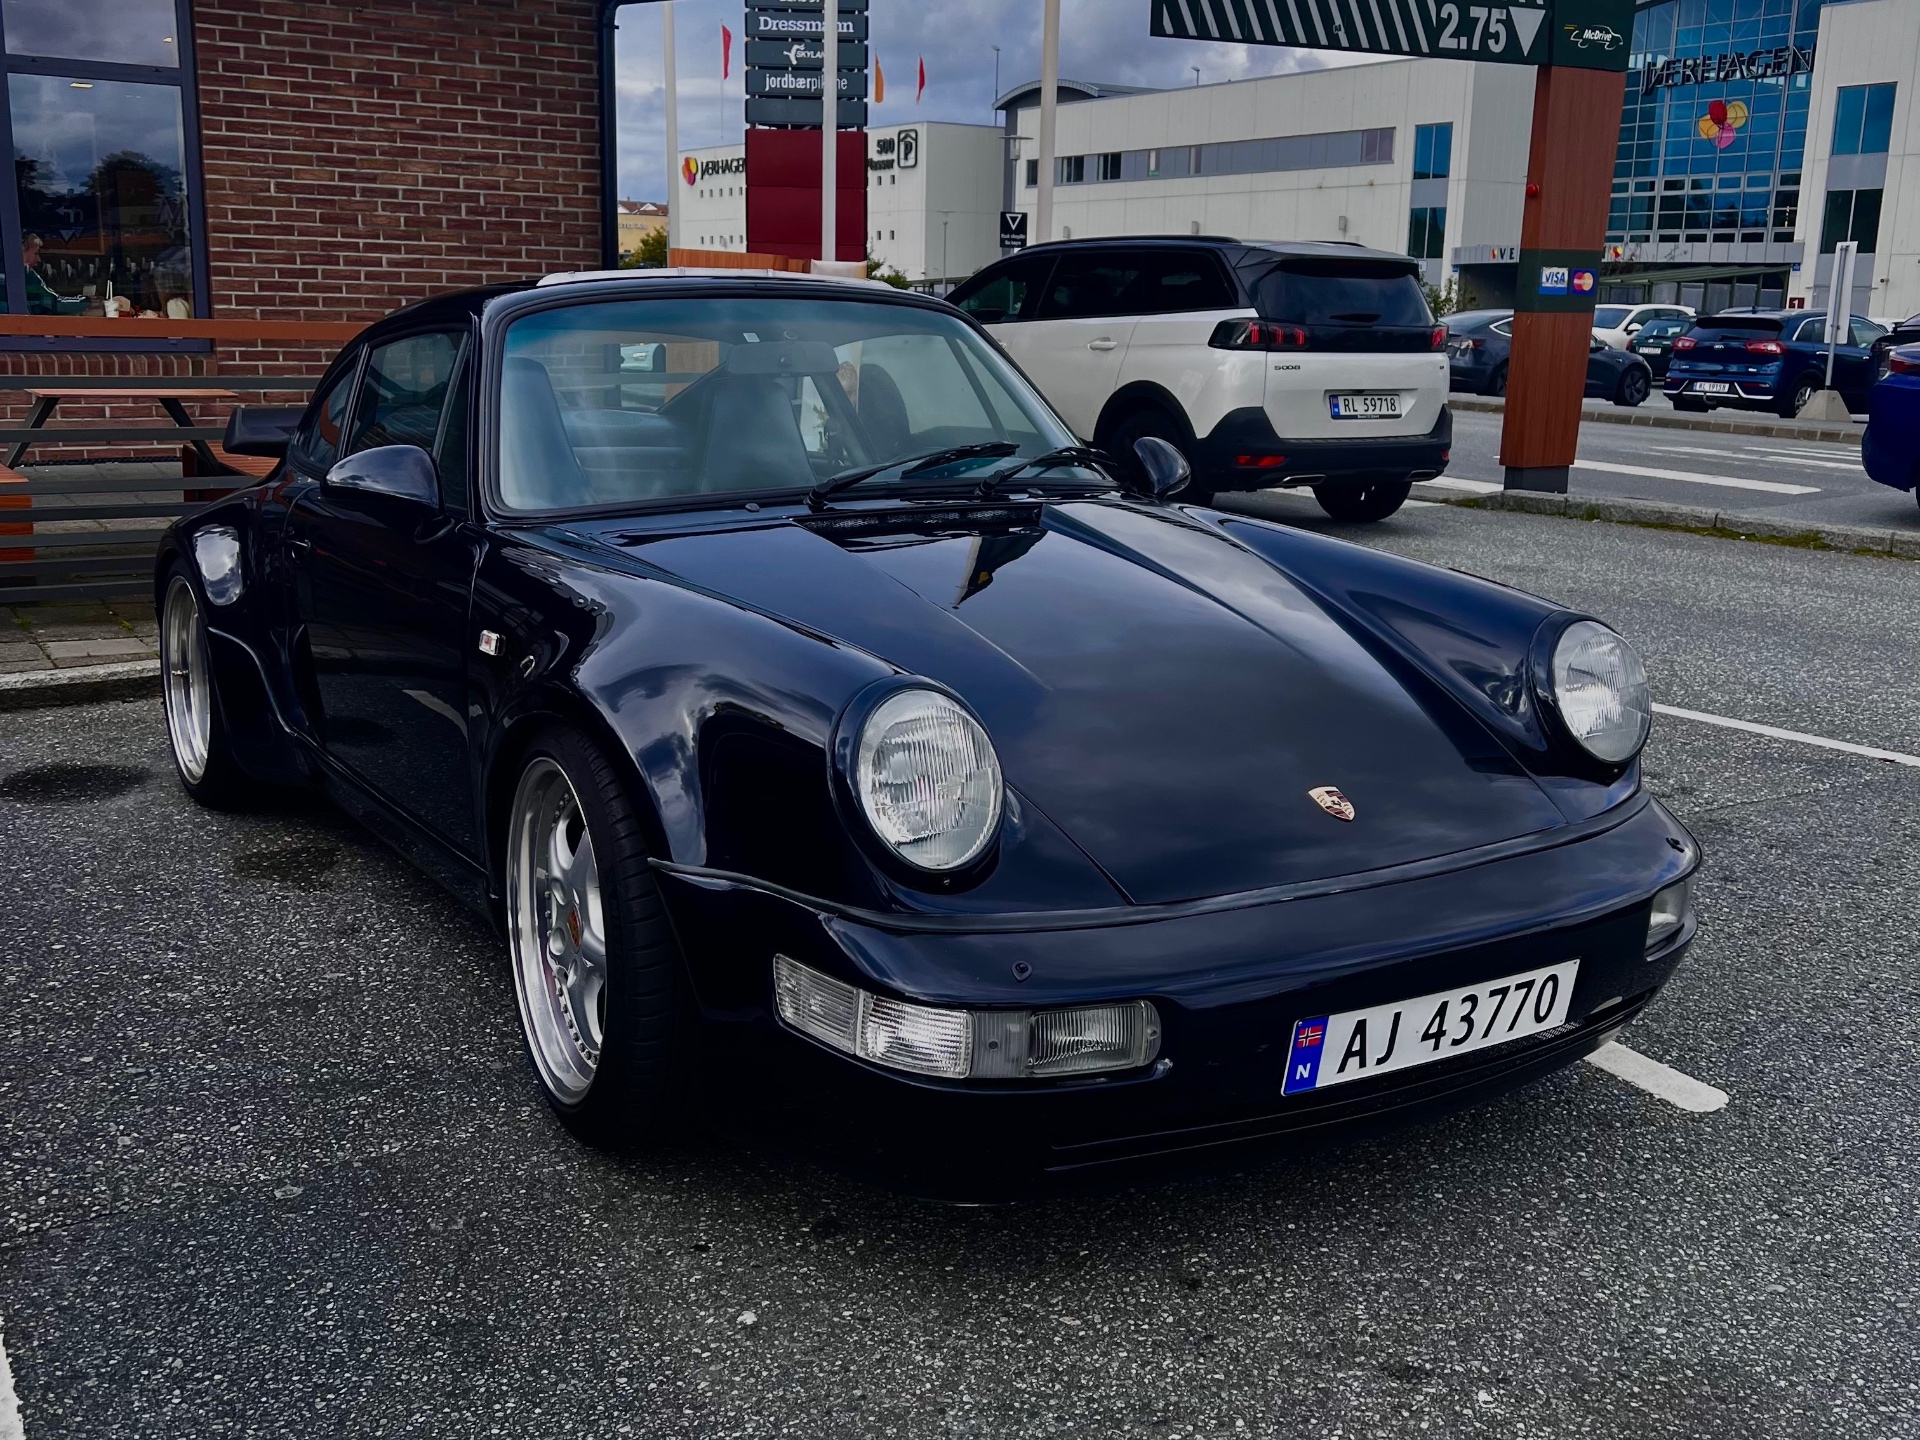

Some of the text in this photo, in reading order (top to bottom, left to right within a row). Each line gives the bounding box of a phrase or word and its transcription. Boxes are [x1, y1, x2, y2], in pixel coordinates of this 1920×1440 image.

[759, 16, 854, 32] Dressmnn
[1438, 3, 1506, 53] 2.75
[1583, 28, 1612, 41] McDrive
[1640, 44, 1817, 95] JÆRHAGEN
[765, 73, 847, 92] jordbærpine
[876, 138, 895, 155] 500
[904, 141, 913, 161] P
[700, 157, 745, 180] JÆRHAGE
[1545, 271, 1565, 284] VISA
[1343, 397, 1397, 413] RL 59718
[1336, 973, 1559, 1074] AJ 43770
[1295, 1062, 1311, 1080] N
